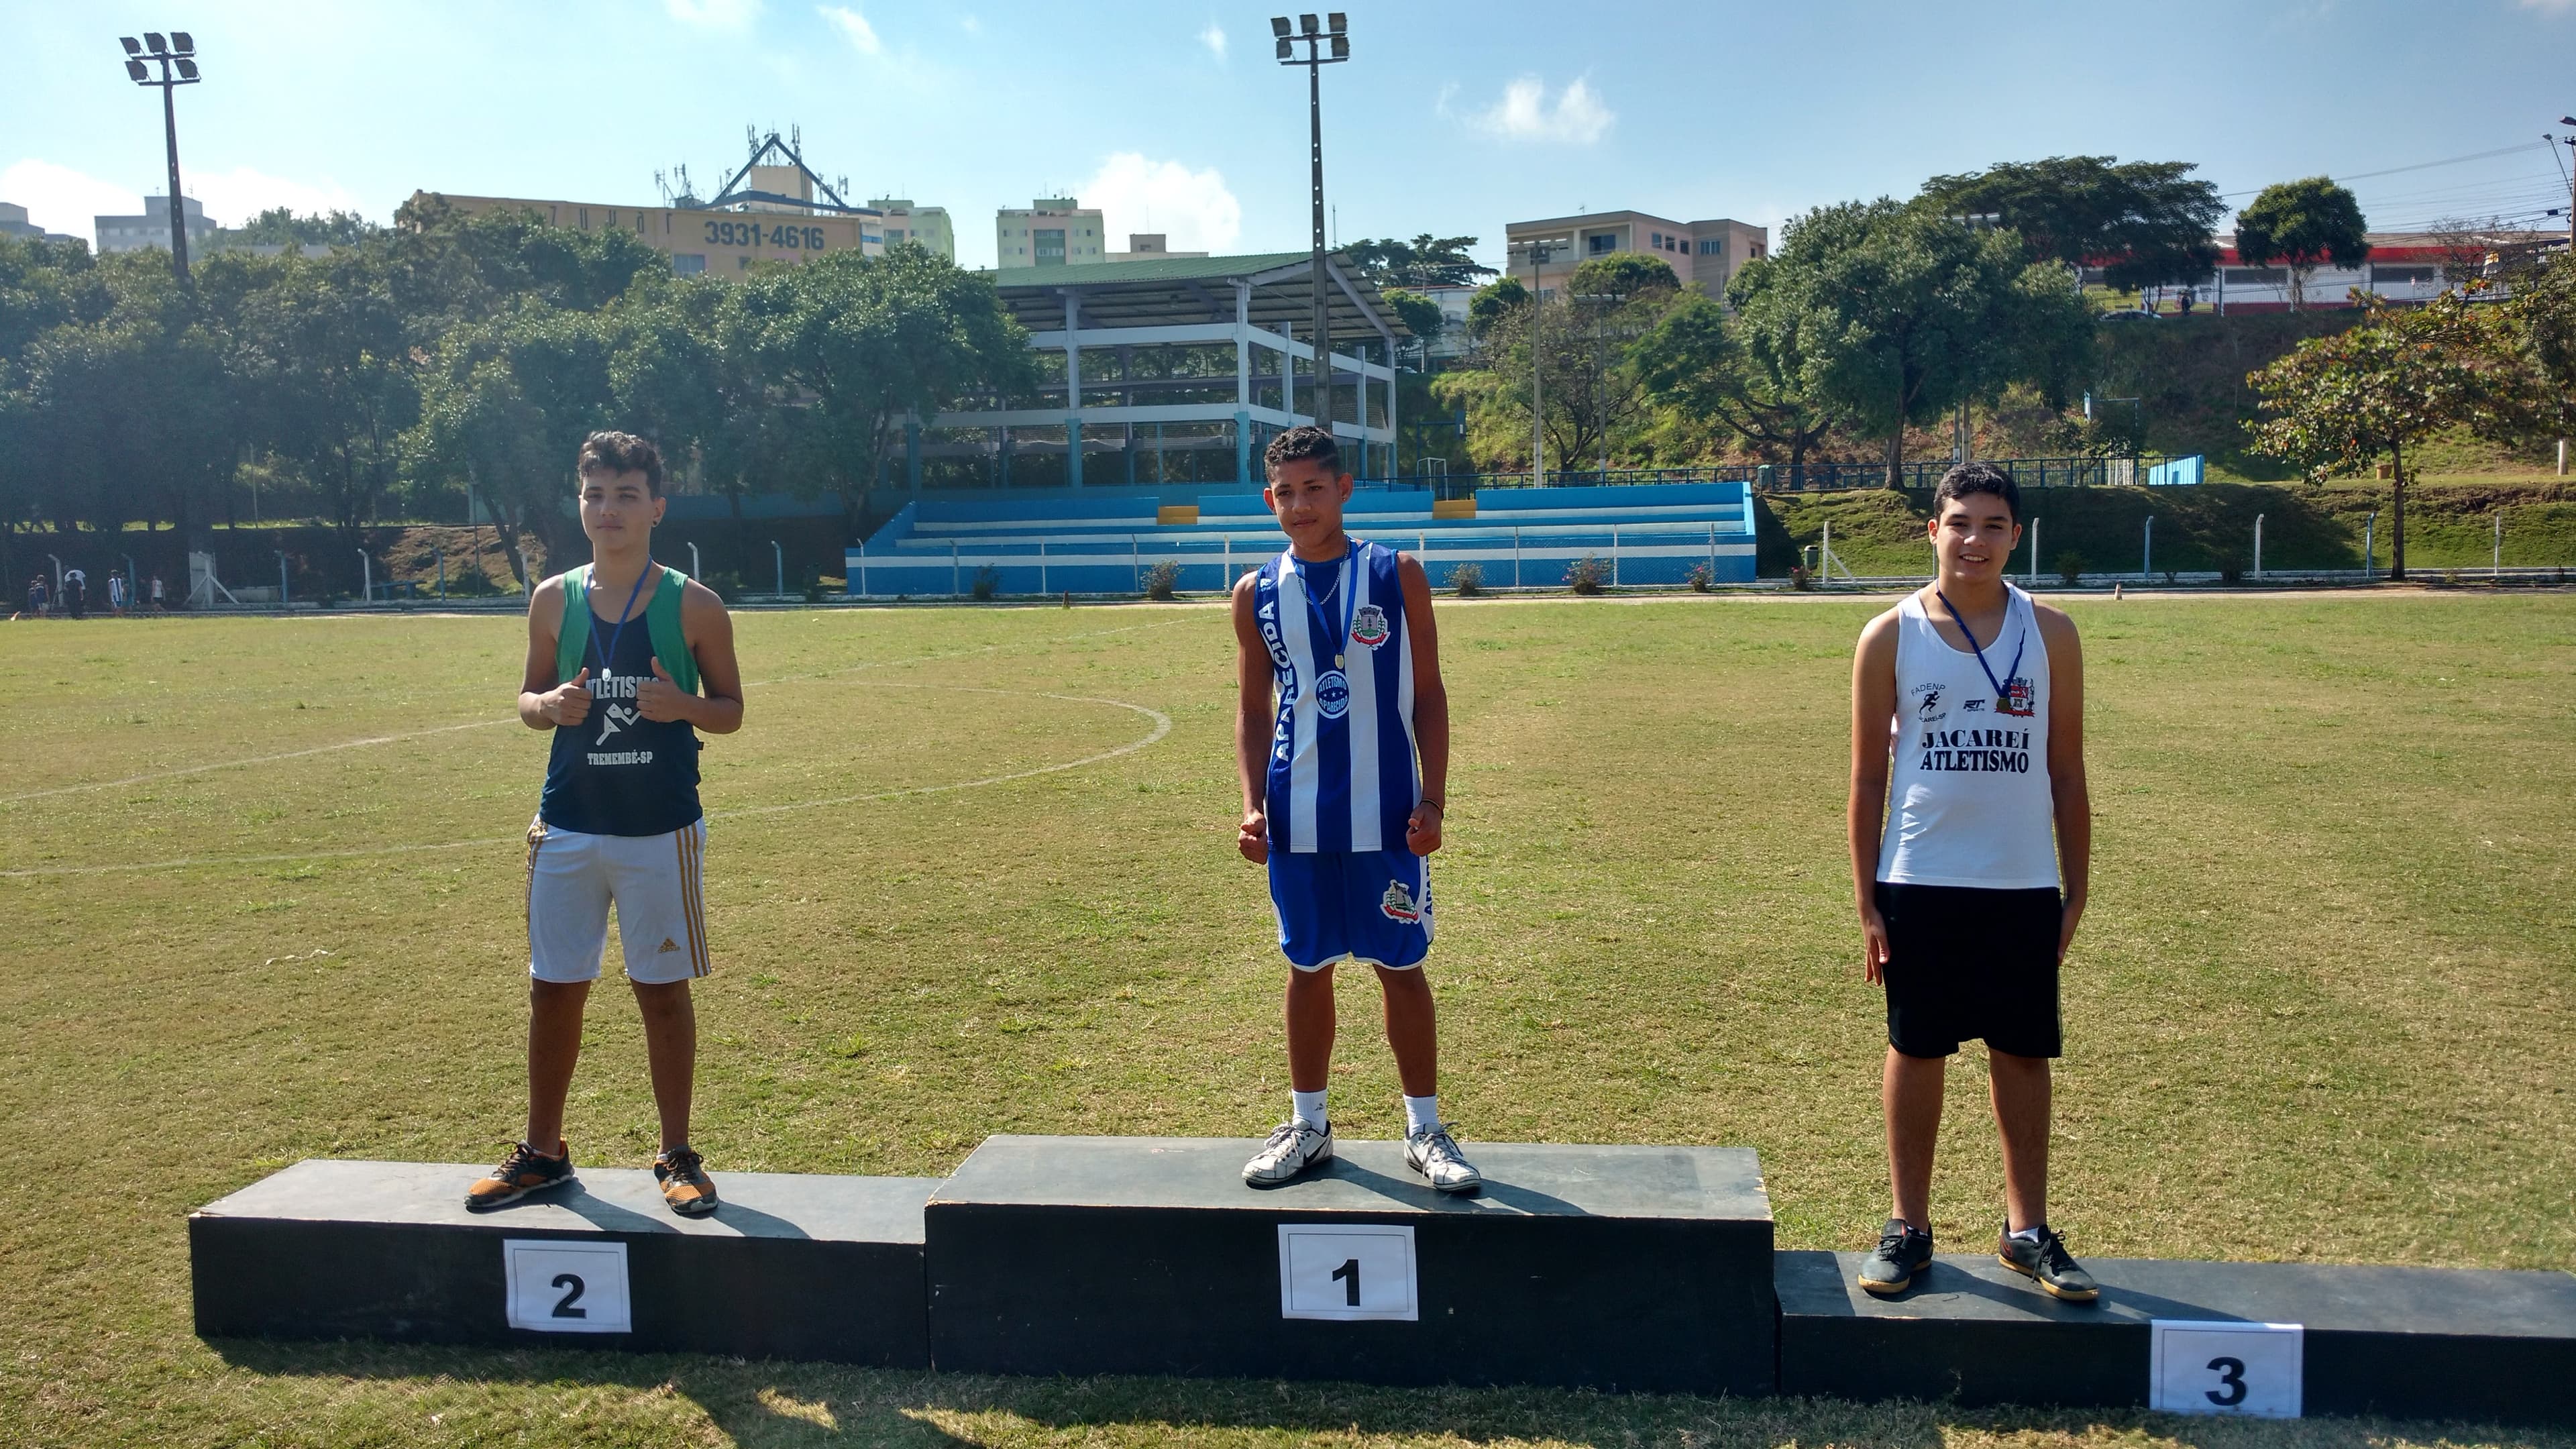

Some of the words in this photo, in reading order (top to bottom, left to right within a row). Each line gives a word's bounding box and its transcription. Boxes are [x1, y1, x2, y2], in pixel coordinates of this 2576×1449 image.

[705, 221, 824, 250] 3931-4616
[586, 676, 659, 699] TLETIS
[1258, 601, 1296, 761] APARECIDA
[1319, 676, 1347, 694] ATLETISMO
[1911, 683, 1946, 696] FADENP
[1319, 695, 1348, 712] APARECIDA
[1922, 729, 2031, 749] JACAREÍ
[588, 749, 653, 765] TREMEMBÉ-SP
[1920, 749, 2029, 773] ATLETISMO
[1332, 1259, 1360, 1306] 1
[551, 1274, 587, 1318] 2
[2205, 1356, 2247, 1406] 3
